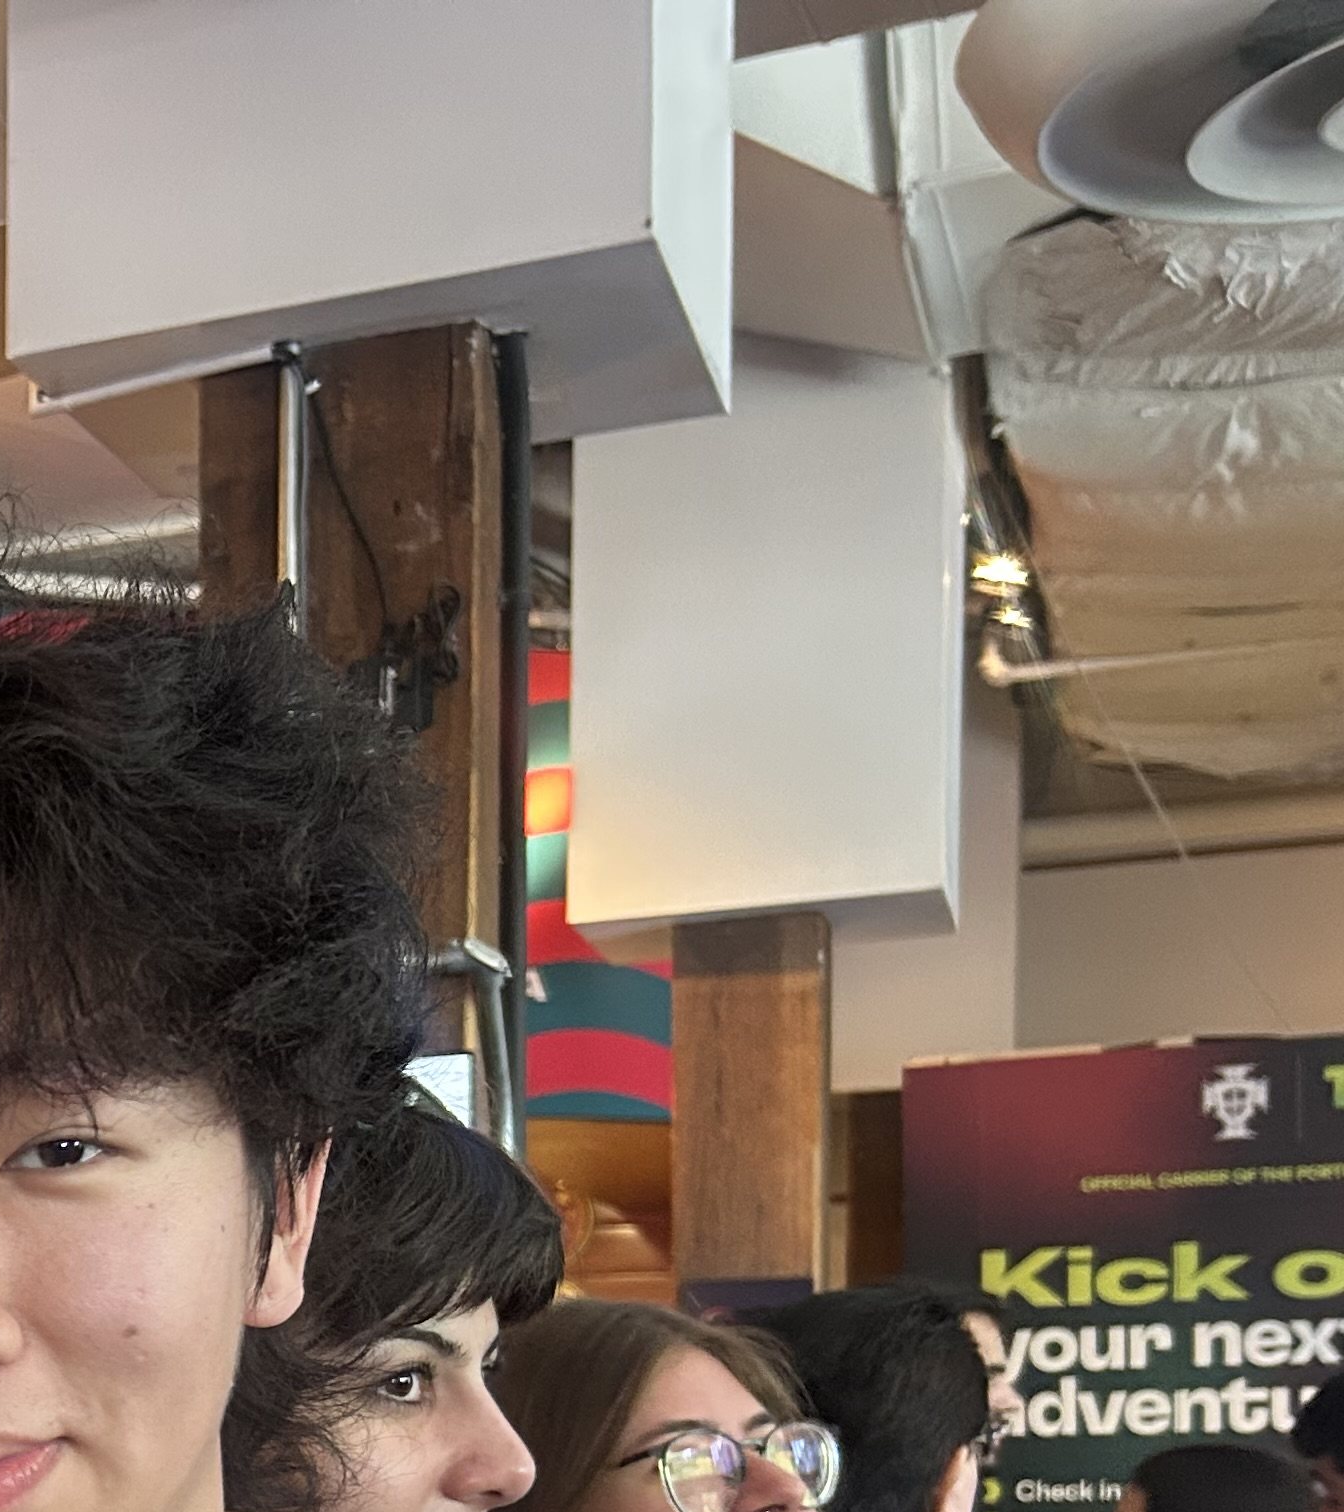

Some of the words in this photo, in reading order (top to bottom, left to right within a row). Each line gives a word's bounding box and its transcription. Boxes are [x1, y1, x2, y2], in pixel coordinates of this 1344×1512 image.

[980, 1240, 1252, 1308] Kick
[1015, 1478, 1094, 1503] Check
[1099, 1478, 1122, 1502] in
